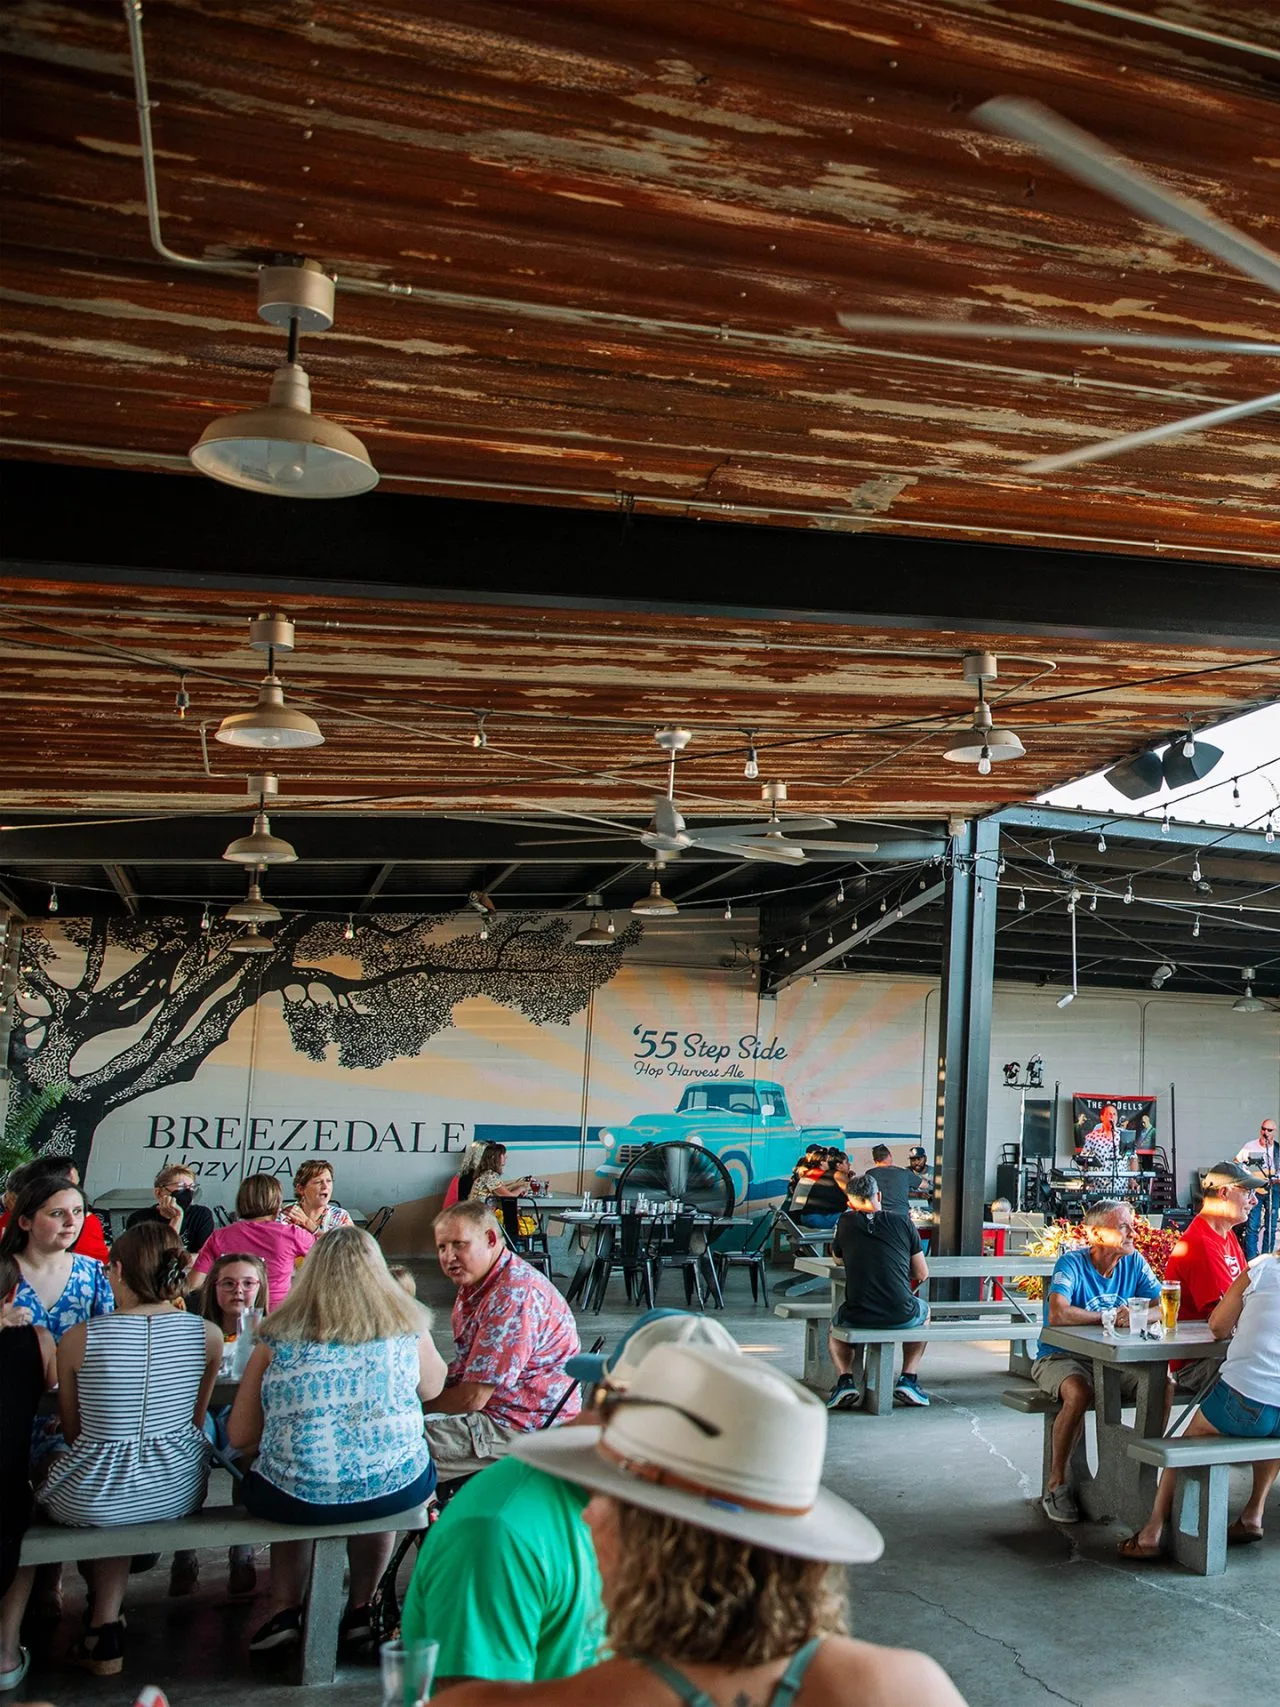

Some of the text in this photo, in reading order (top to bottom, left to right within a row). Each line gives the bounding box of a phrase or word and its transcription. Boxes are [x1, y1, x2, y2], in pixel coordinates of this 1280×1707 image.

[683, 1033, 730, 1063] Step
[738, 1035, 788, 1060] Side
[634, 1061, 745, 1078] Hop Harvest Ale
[1087, 1100, 1102, 1109] THE
[143, 1115, 467, 1153] BREEZEDALE
[247, 1156, 293, 1177] IPA
